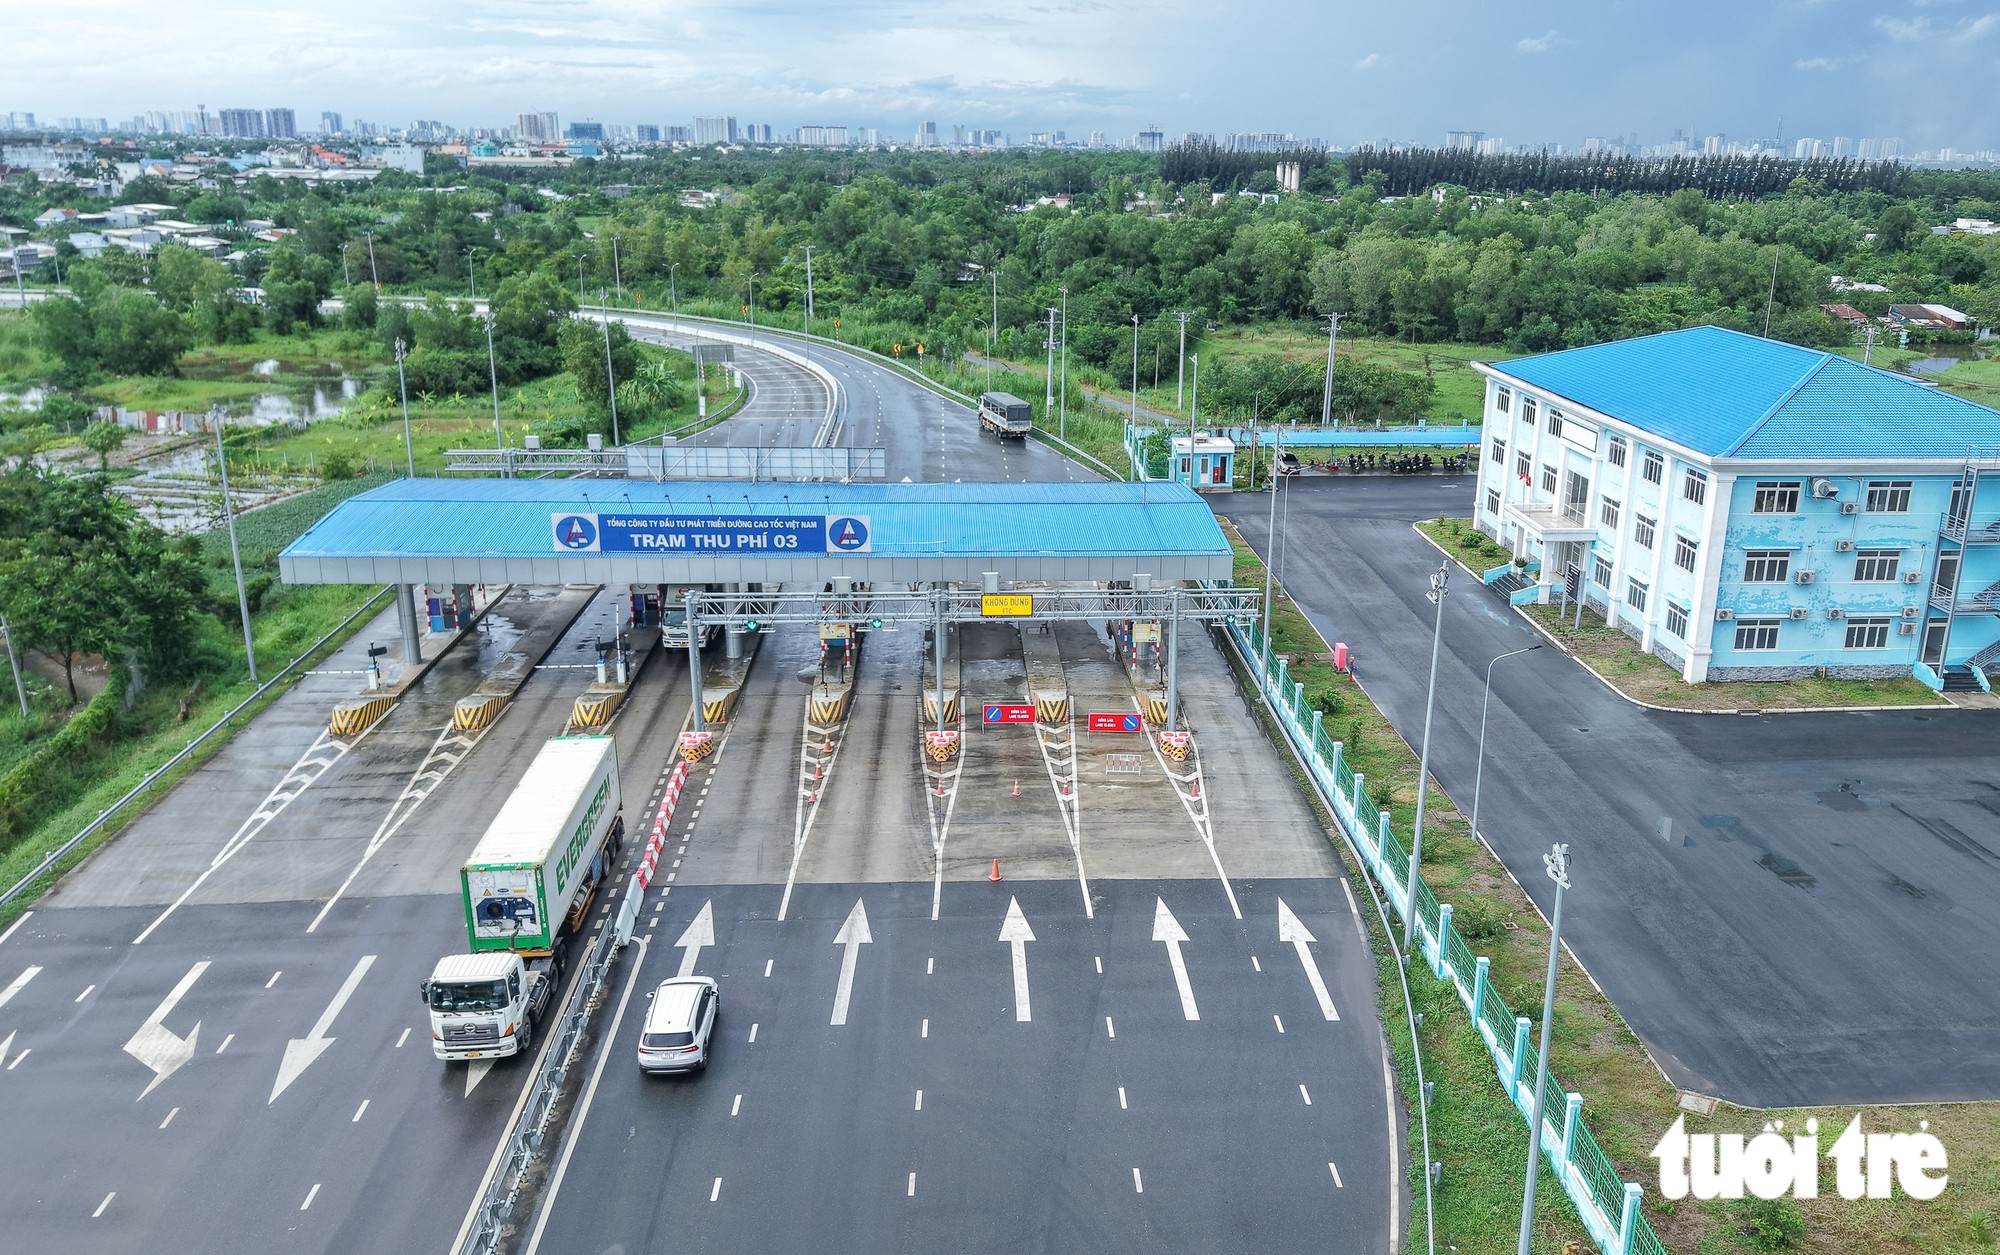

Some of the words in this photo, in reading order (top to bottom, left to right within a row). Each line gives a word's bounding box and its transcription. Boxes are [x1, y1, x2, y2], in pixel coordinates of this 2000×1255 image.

[607, 516, 626, 528] TỔNG
[628, 518, 648, 528] CÔNG
[649, 520, 658, 528] TY
[676, 520, 686, 528] TƯ
[688, 518, 706, 528] PHÁT
[706, 517, 726, 528] TRIỂN
[754, 520, 768, 528] CAO
[770, 518, 784, 528] TỐC
[784, 520, 800, 530] VIỆT
[630, 534, 686, 552] TRẠM
[692, 534, 731, 548] THU
[736, 532, 768, 548] PHÍ
[774, 534, 798, 548] 03
[555, 773, 611, 895] EVERGREEN
